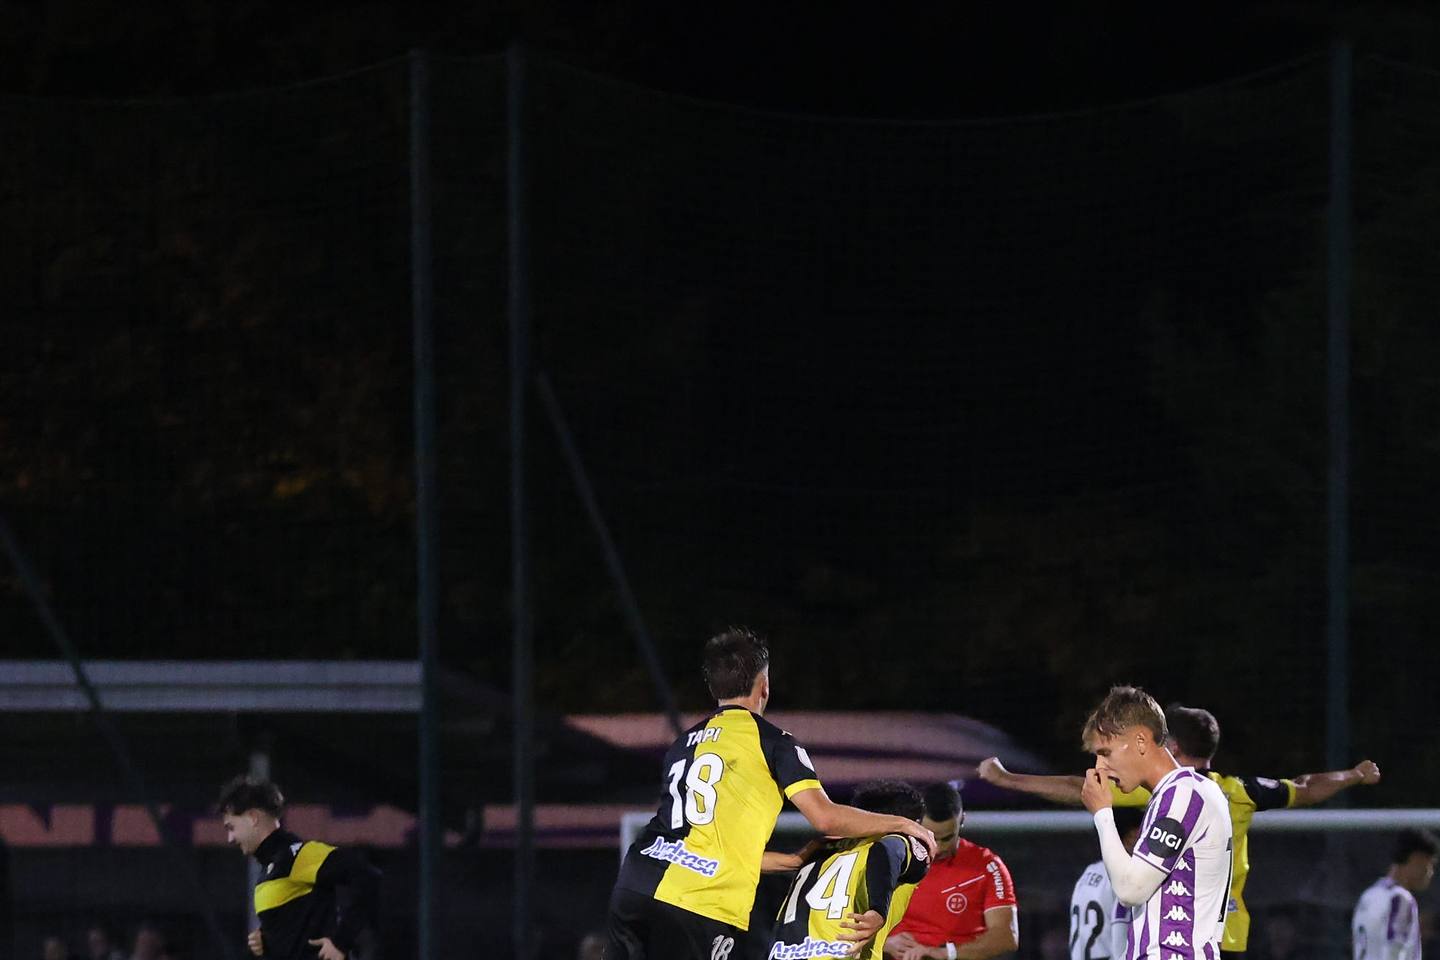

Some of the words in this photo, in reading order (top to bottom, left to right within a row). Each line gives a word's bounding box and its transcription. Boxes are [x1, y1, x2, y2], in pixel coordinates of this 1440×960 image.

[686, 727, 723, 748] TAPI
[667, 752, 725, 830] 18
[640, 836, 720, 878] Andrasa
[1149, 826, 1183, 851] DIGI
[783, 850, 860, 925] 14
